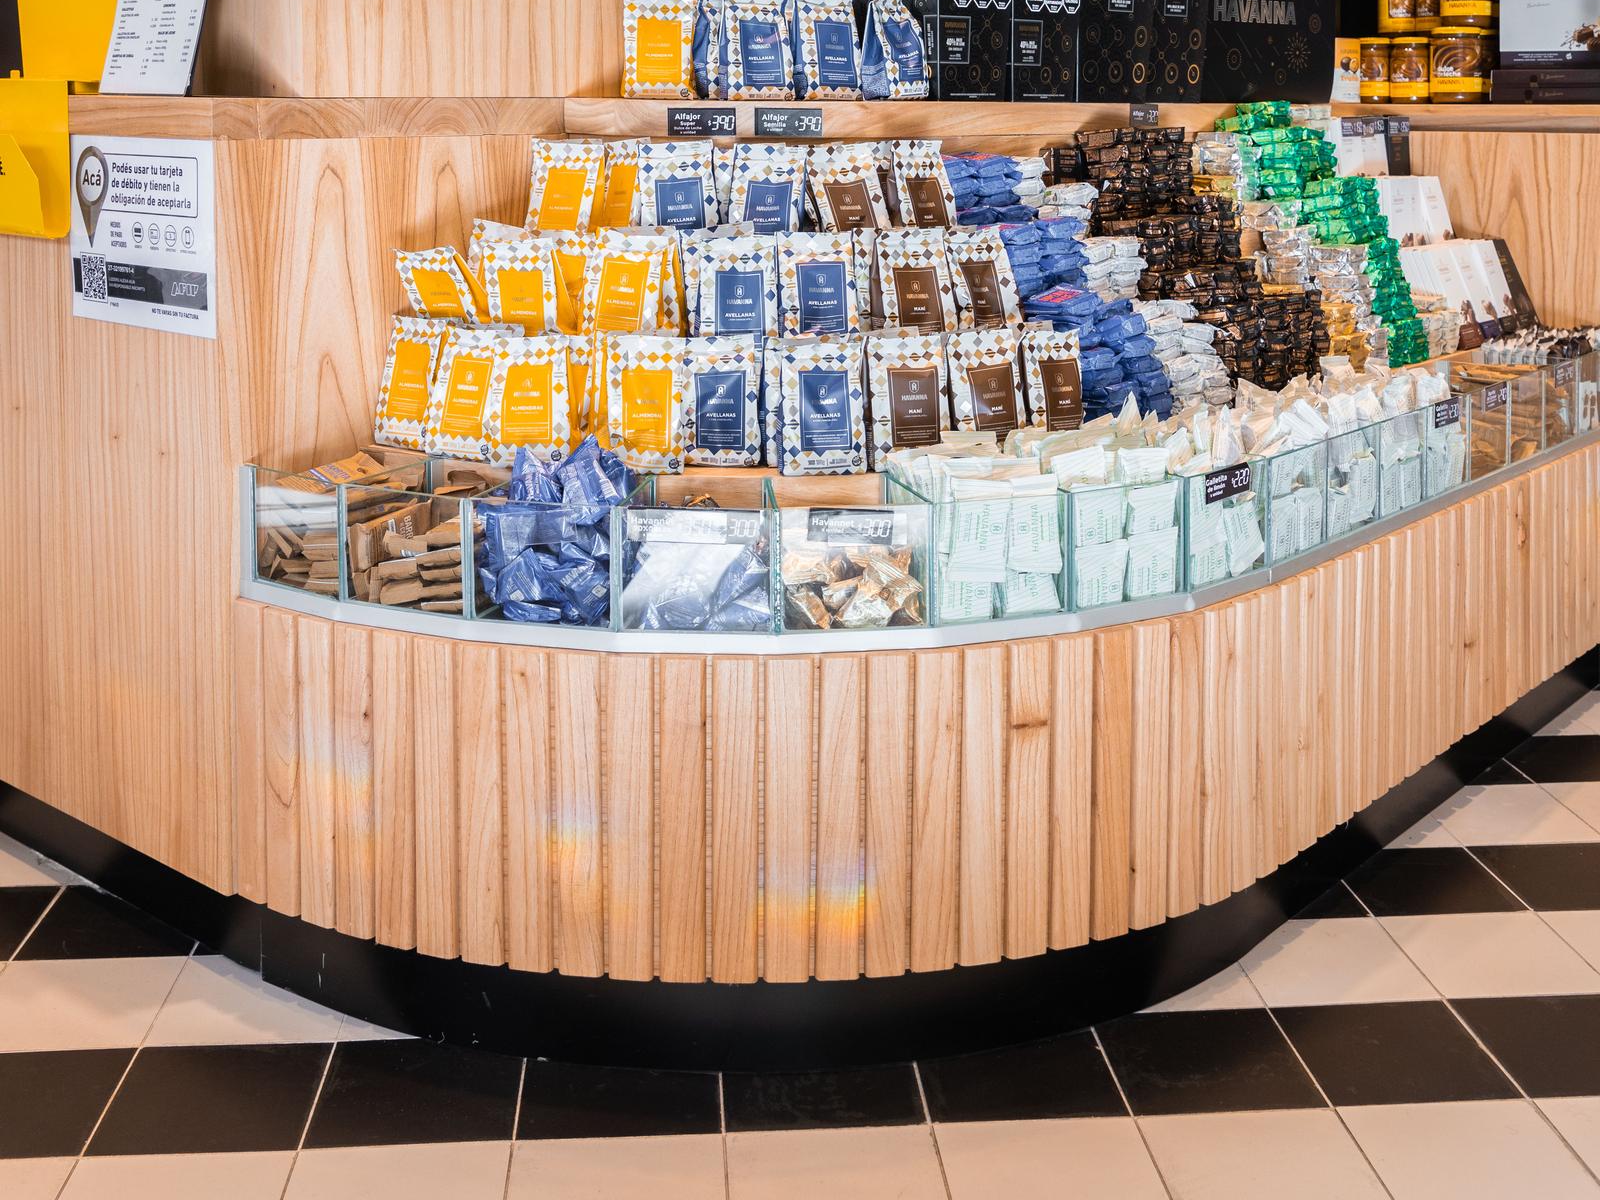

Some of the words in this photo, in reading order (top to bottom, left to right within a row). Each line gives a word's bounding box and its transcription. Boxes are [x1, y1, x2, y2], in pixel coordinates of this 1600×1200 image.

[898, 51, 920, 59] AVELLANAS
[674, 112, 701, 121] Alfajor
[707, 115, 735, 131] $390
[761, 113, 788, 122] Alfajor
[794, 115, 822, 131] $390
[111, 162, 133, 174] Podés
[133, 165, 150, 175] usar
[150, 166, 158, 175] tu
[159, 166, 183, 178] tarjeta
[82, 169, 102, 187] Acá
[111, 178, 120, 188] de
[120, 178, 143, 190] débito
[143, 183, 148, 192] y
[149, 180, 172, 192] tienen
[173, 181, 180, 192] la
[110, 194, 146, 206] obligación
[146, 196, 156, 206] de
[157, 197, 191, 210] aceptarla
[183, 312, 199, 320] FACTURA
[901, 393, 928, 401] HAVANNA
[810, 411, 841, 419] AVELLANAS
[908, 406, 923, 414] MANÍ
[1205, 473, 1228, 487] Galletita
[1207, 485, 1214, 493] de
[1214, 482, 1226, 491] limón
[811, 517, 855, 527] Havannet
[978, 503, 991, 551] HAVANNA
[1030, 504, 1039, 553] HAVANNA
